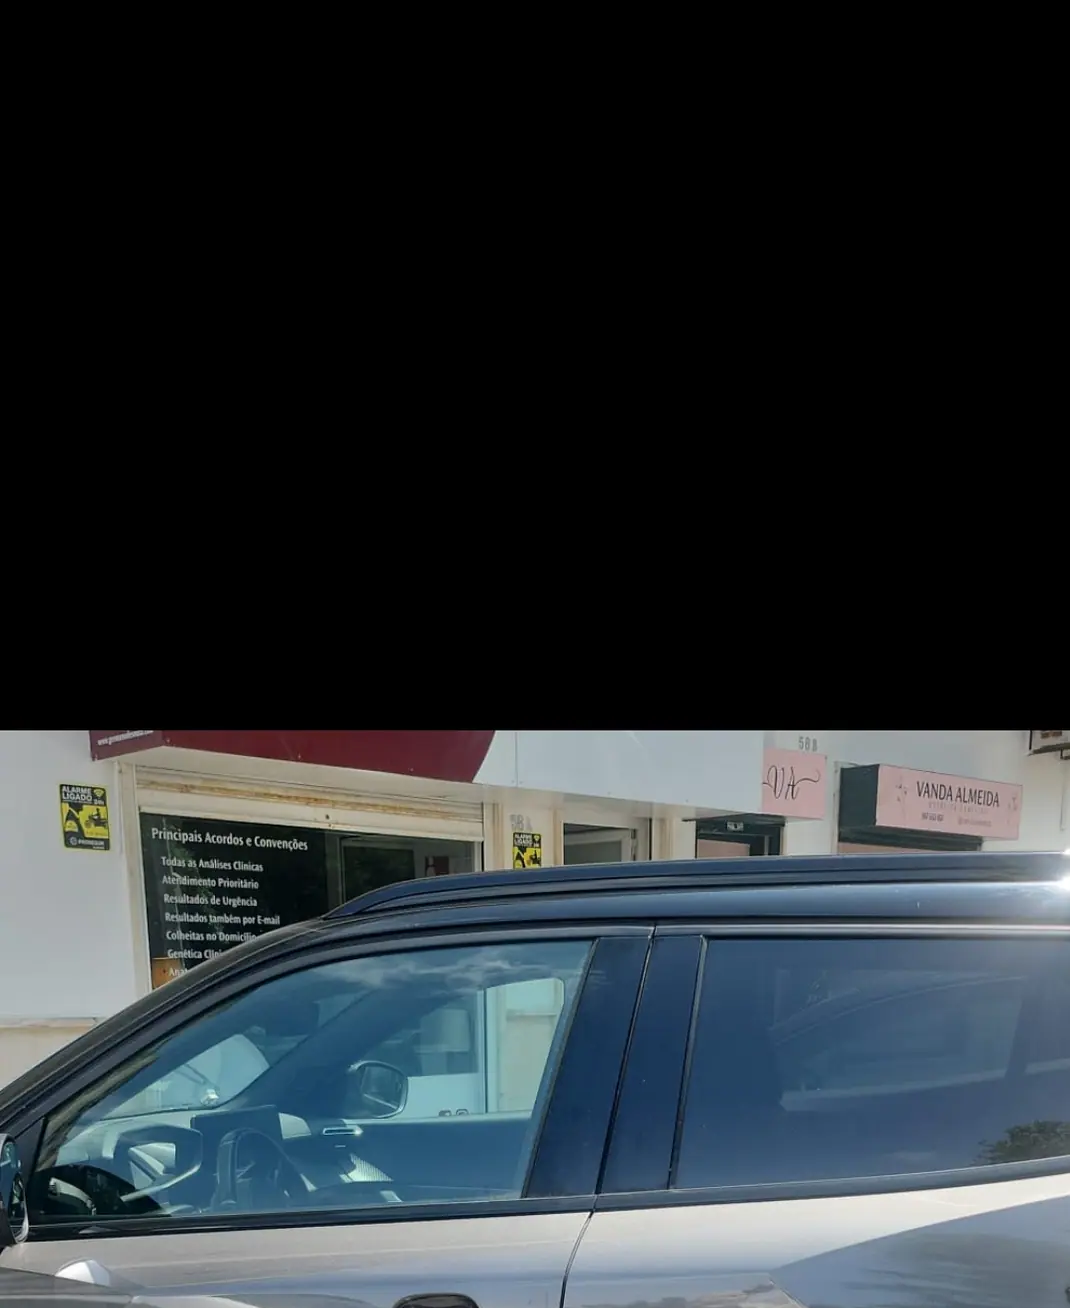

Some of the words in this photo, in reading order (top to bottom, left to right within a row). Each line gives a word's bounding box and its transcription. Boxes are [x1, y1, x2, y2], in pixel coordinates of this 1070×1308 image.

[62, 785, 92, 794] ALARME
[762, 765, 821, 800] VA
[62, 791, 93, 801] LIGADO
[916, 781, 953, 801] VANDA
[954, 786, 1000, 808] ALMEIDA
[151, 827, 202, 844] Principais
[204, 832, 243, 846] Acordos
[245, 837, 253, 847] e
[254, 836, 308, 852] Convenções
[161, 856, 186, 867] Todas
[188, 859, 197, 868] as
[198, 859, 232, 870] Análises
[162, 875, 216, 888] Atendimento
[218, 877, 259, 890] Prioritário
[163, 893, 209, 905] Resultados
[211, 895, 221, 905] de
[222, 896, 258, 908] Urgência
[165, 912, 208, 923] Resultados
[209, 913, 241, 924] também
[242, 916, 255, 926] por
[257, 915, 280, 925] E-mail
[166, 930, 204, 941] Colheitas
[167, 949, 203, 959] Genética
